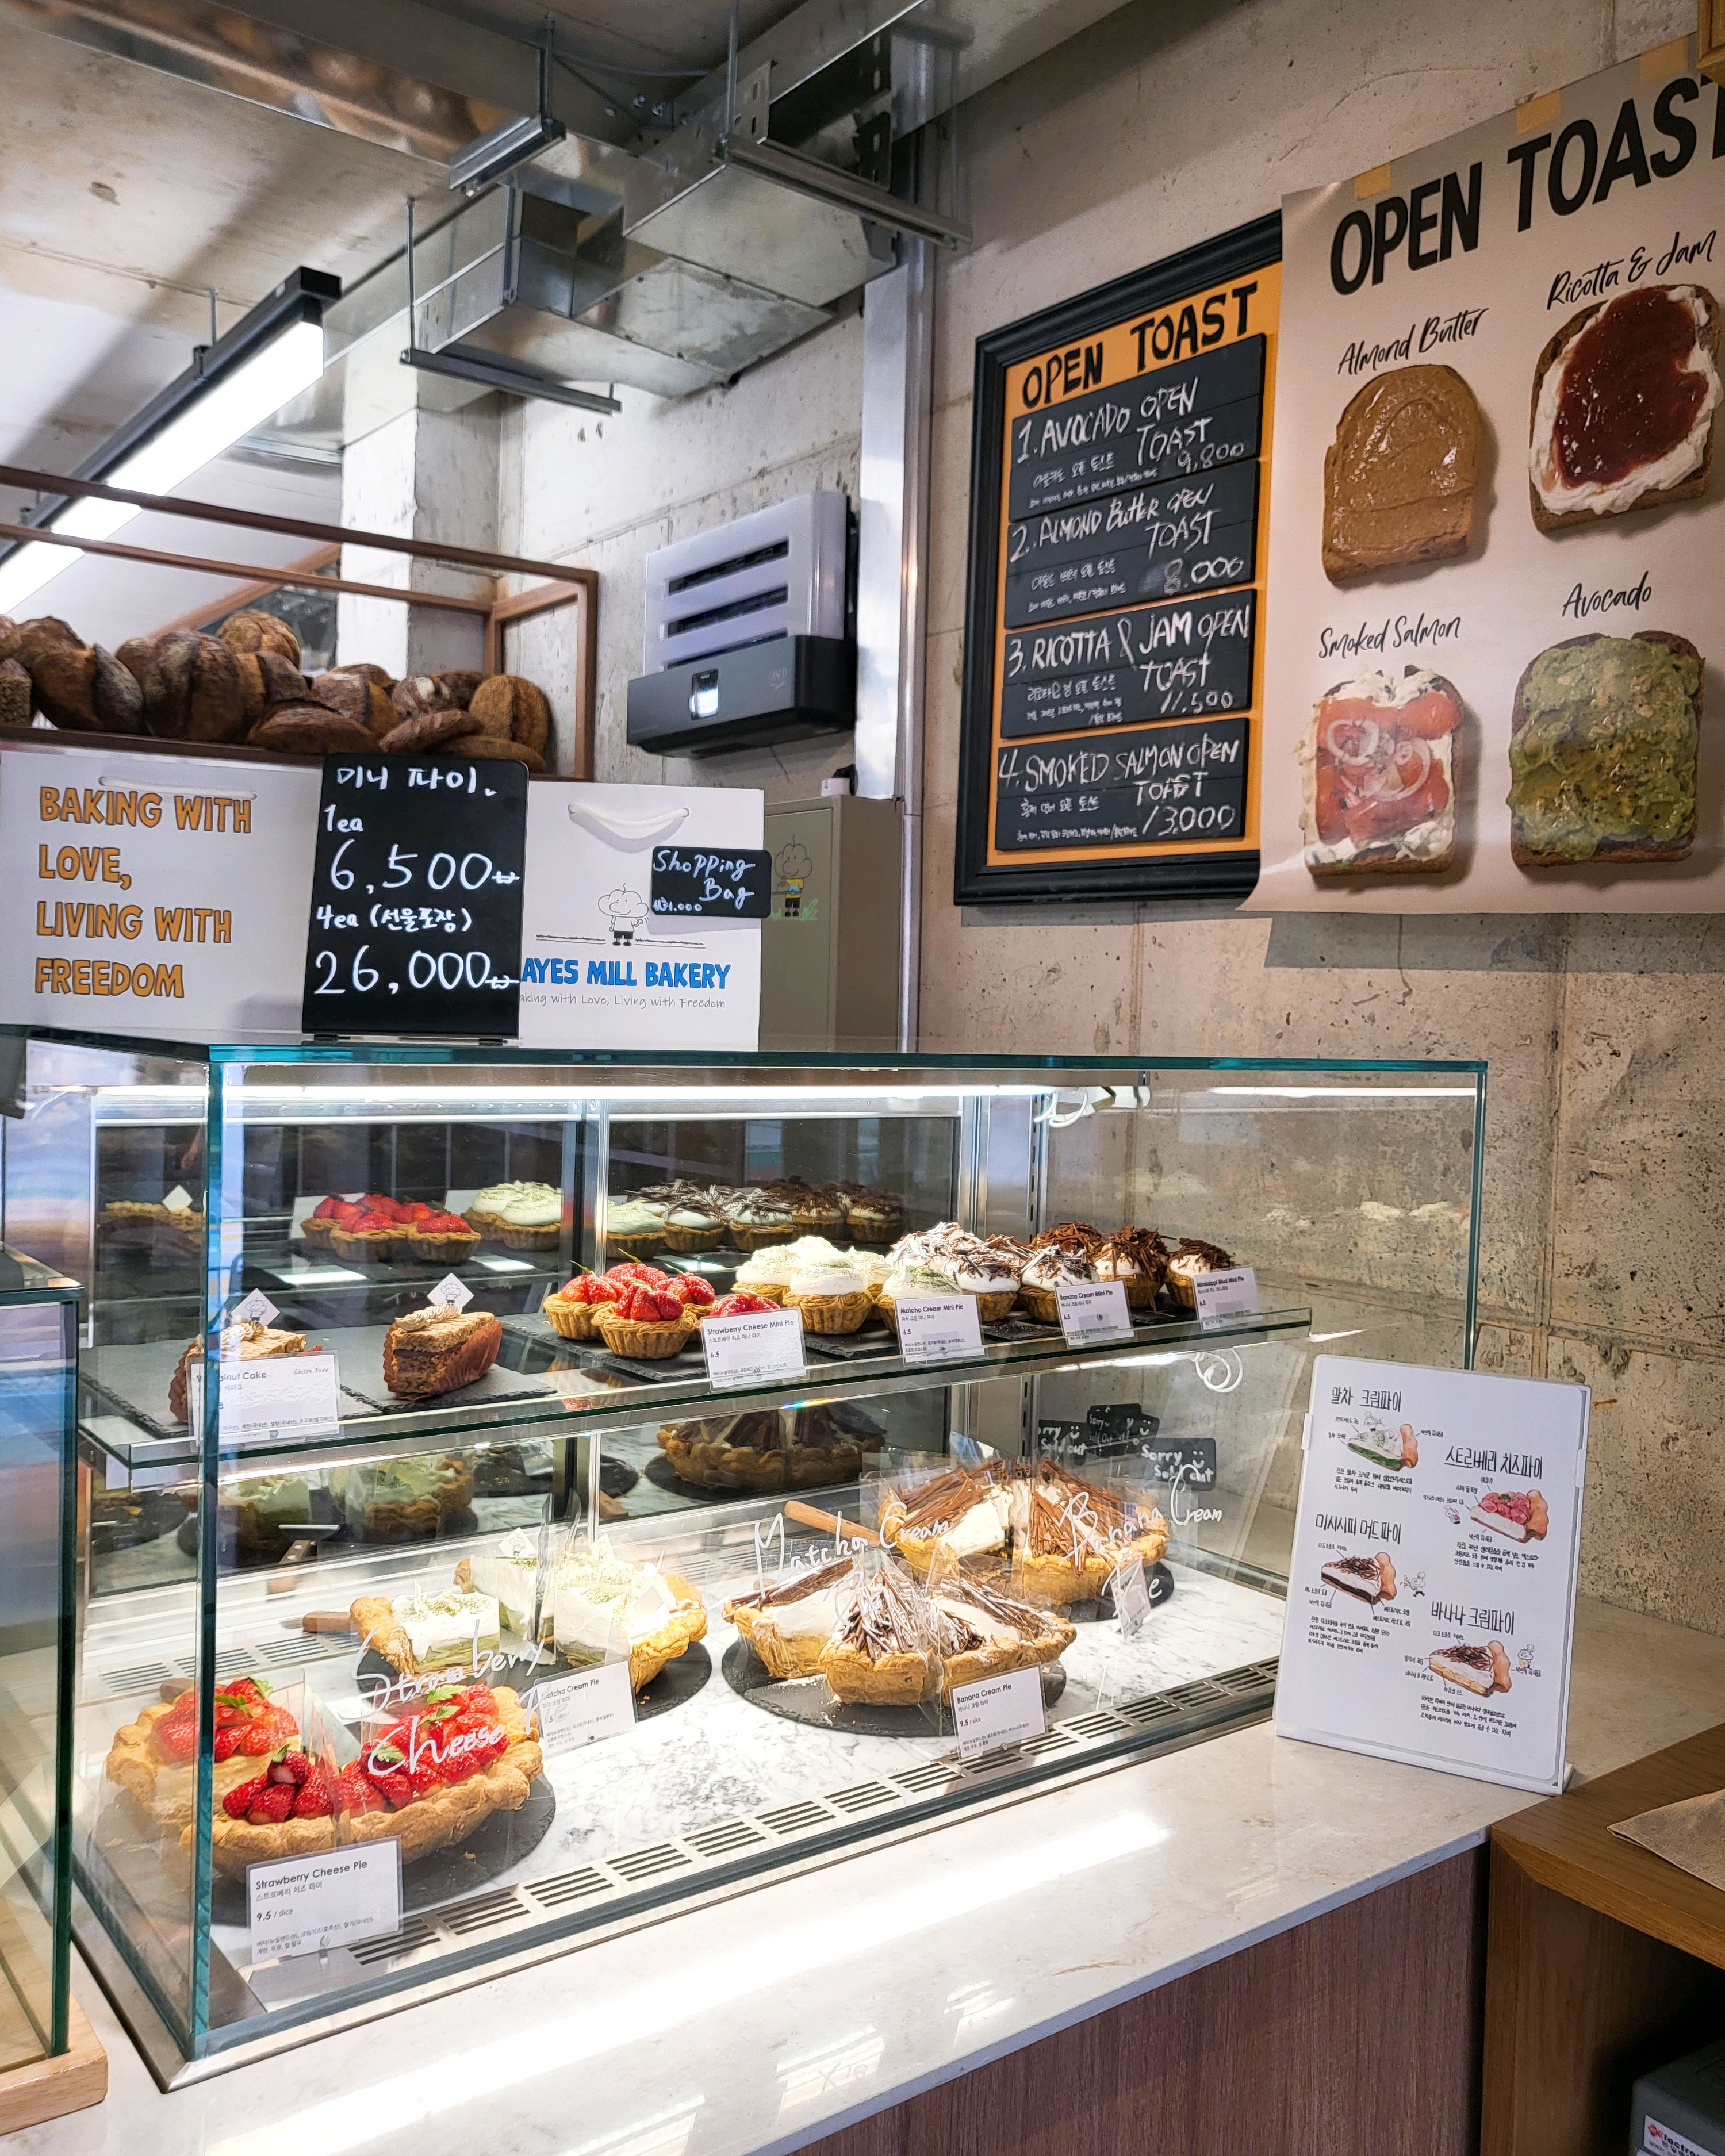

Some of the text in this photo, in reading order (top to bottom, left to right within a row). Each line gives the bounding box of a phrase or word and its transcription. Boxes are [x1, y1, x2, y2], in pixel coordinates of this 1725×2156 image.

[1330, 161, 1482, 296] OPEN
[1547, 258, 1624, 310] Ricotta
[1627, 247, 1651, 282] &
[1022, 281, 1258, 409] OPEN TOAST
[1337, 307, 1489, 375] Almond Butter
[1140, 375, 1199, 420] OPEN
[1136, 417, 1213, 466] TOAST
[1145, 509, 1221, 559] TOAST
[1562, 570, 1652, 619] Avocado
[1032, 627, 1113, 669] RICOTTA
[1197, 604, 1251, 649] OPEN
[1319, 613, 1461, 659] Smoked Salmon
[336, 765, 388, 790] 미니
[1025, 753, 1109, 793] SMOKED
[1114, 741, 1185, 781] SALMON
[1187, 732, 1240, 769] OPEN
[40, 786, 251, 833] BAKING WITH
[323, 804, 363, 833] 1ea
[39, 845, 132, 890] LOVE,
[653, 850, 756, 881] Shopping
[699, 878, 754, 910] Bag
[37, 901, 232, 943] LIVING WITH
[316, 904, 359, 930] 4ea
[35, 957, 184, 998] FREEDOM
[586, 961, 638, 987] MILL
[645, 962, 731, 989] BAKERY
[552, 993, 576, 1004] with
[582, 994, 610, 1006] Love,
[615, 995, 646, 1010] Living
[651, 997, 675, 1007] with
[680, 997, 726, 1008] Freedom
[708, 1326, 741, 1335] Strawberry
[243, 1372, 267, 1380] Cake
[1331, 1386, 1402, 1412] 말차 크림파이
[1141, 1444, 1182, 1465] Sorry
[1444, 1446, 1543, 1479] 스트로베리 치즈파이
[1190, 1467, 1213, 1482] out
[1170, 1464, 1222, 1526] Cream
[1316, 1514, 1356, 1536] 미시시피
[754, 1501, 949, 1599] Matcha Cream
[1431, 1601, 1466, 1626] 바나나
[1467, 1607, 1515, 1635] 크림파이
[567, 1683, 588, 1693] Cream
[957, 1693, 979, 1704] Banana
[981, 1687, 1001, 1697] Cream
[960, 1719, 968, 1727] 9.5
[369, 1718, 504, 1775] Cheese
[256, 1861, 367, 1890] Strawberry Cheese Pie
[256, 1881, 322, 1901] 스트로베리 치즈 파이
[257, 1911, 271, 1922] 9.5
[279, 1908, 293, 1917] slice
